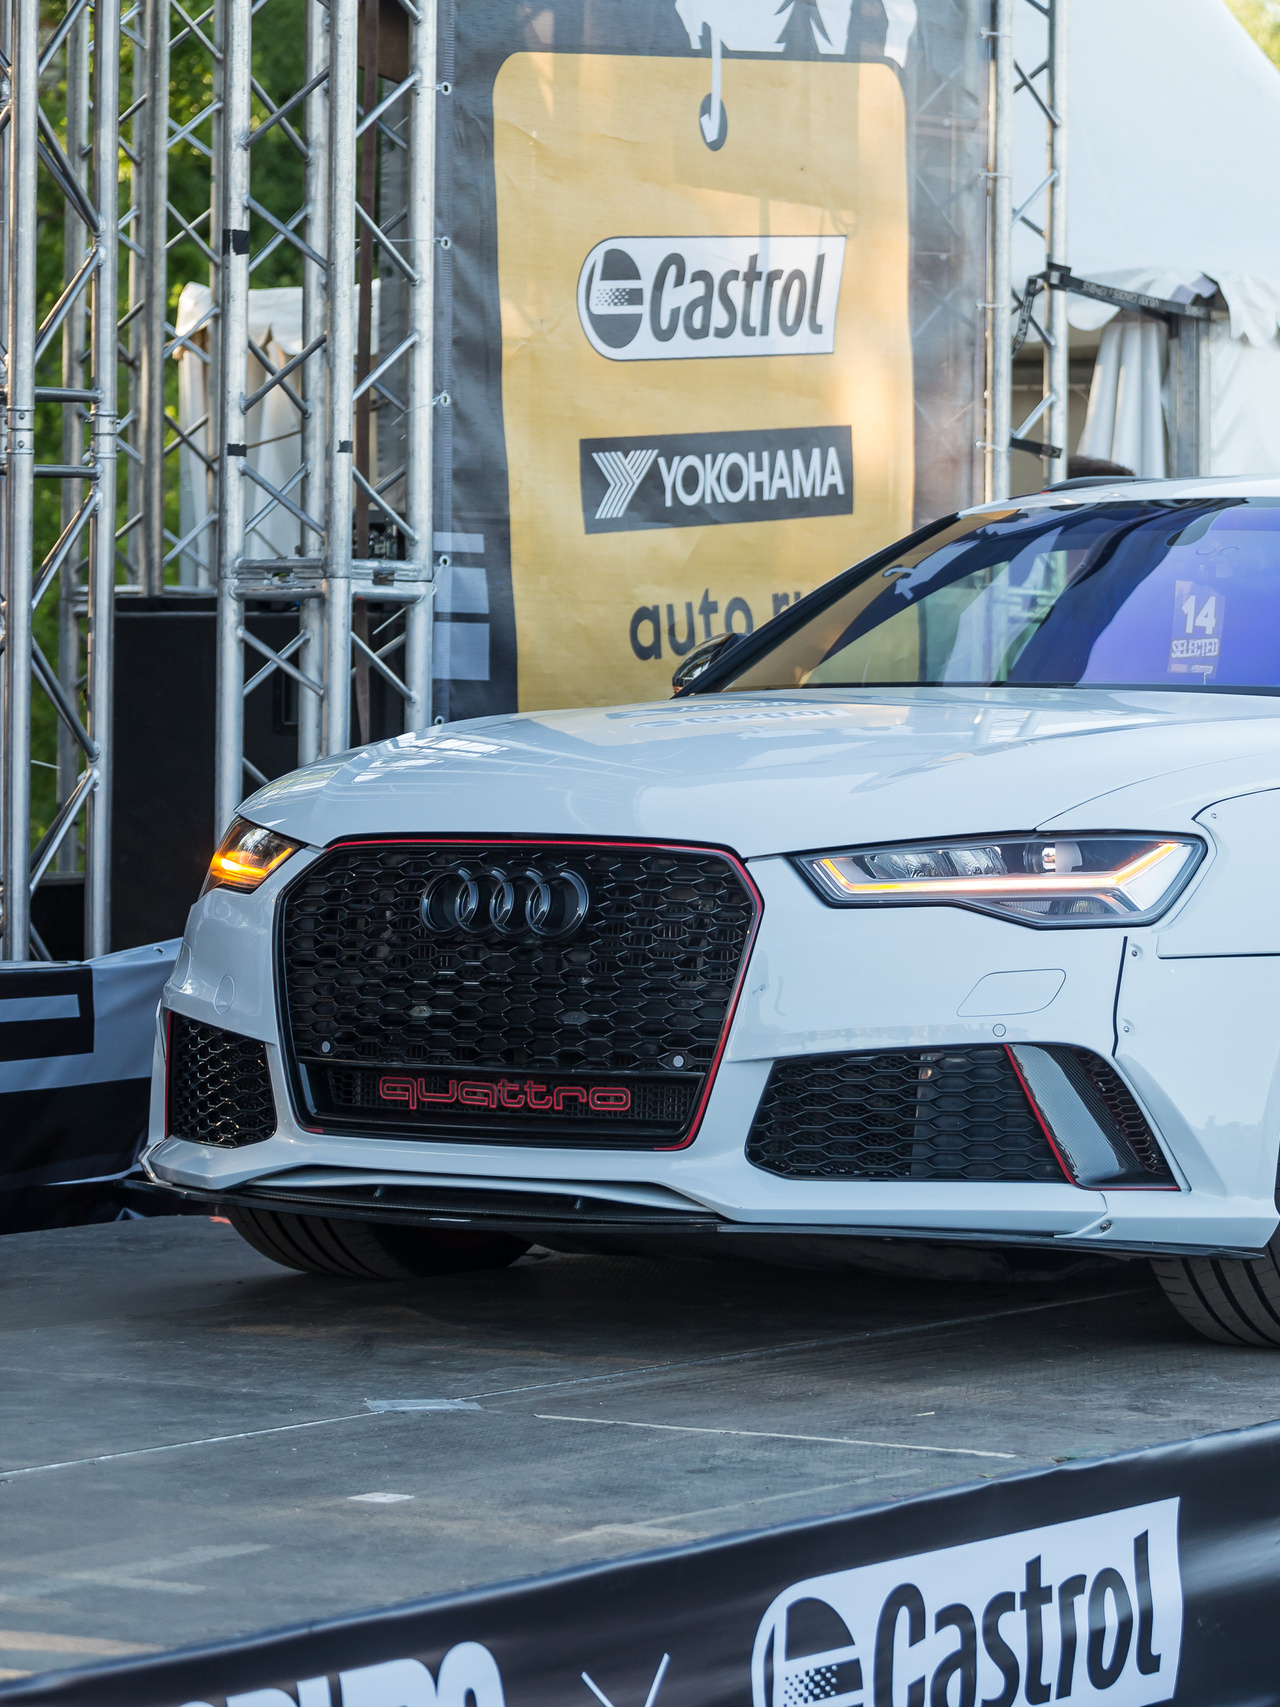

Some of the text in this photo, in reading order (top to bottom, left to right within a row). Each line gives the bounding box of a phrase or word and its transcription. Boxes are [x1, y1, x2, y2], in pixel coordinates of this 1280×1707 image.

[648, 251, 825, 342] Castrol
[656, 446, 845, 507] YOKOHAMA
[629, 587, 754, 661] auto
[1181, 594, 1216, 635] 14
[1171, 637, 1219, 658] SELECTED
[379, 1076, 631, 1111] quattro
[873, 1528, 1162, 1706] Castrol
